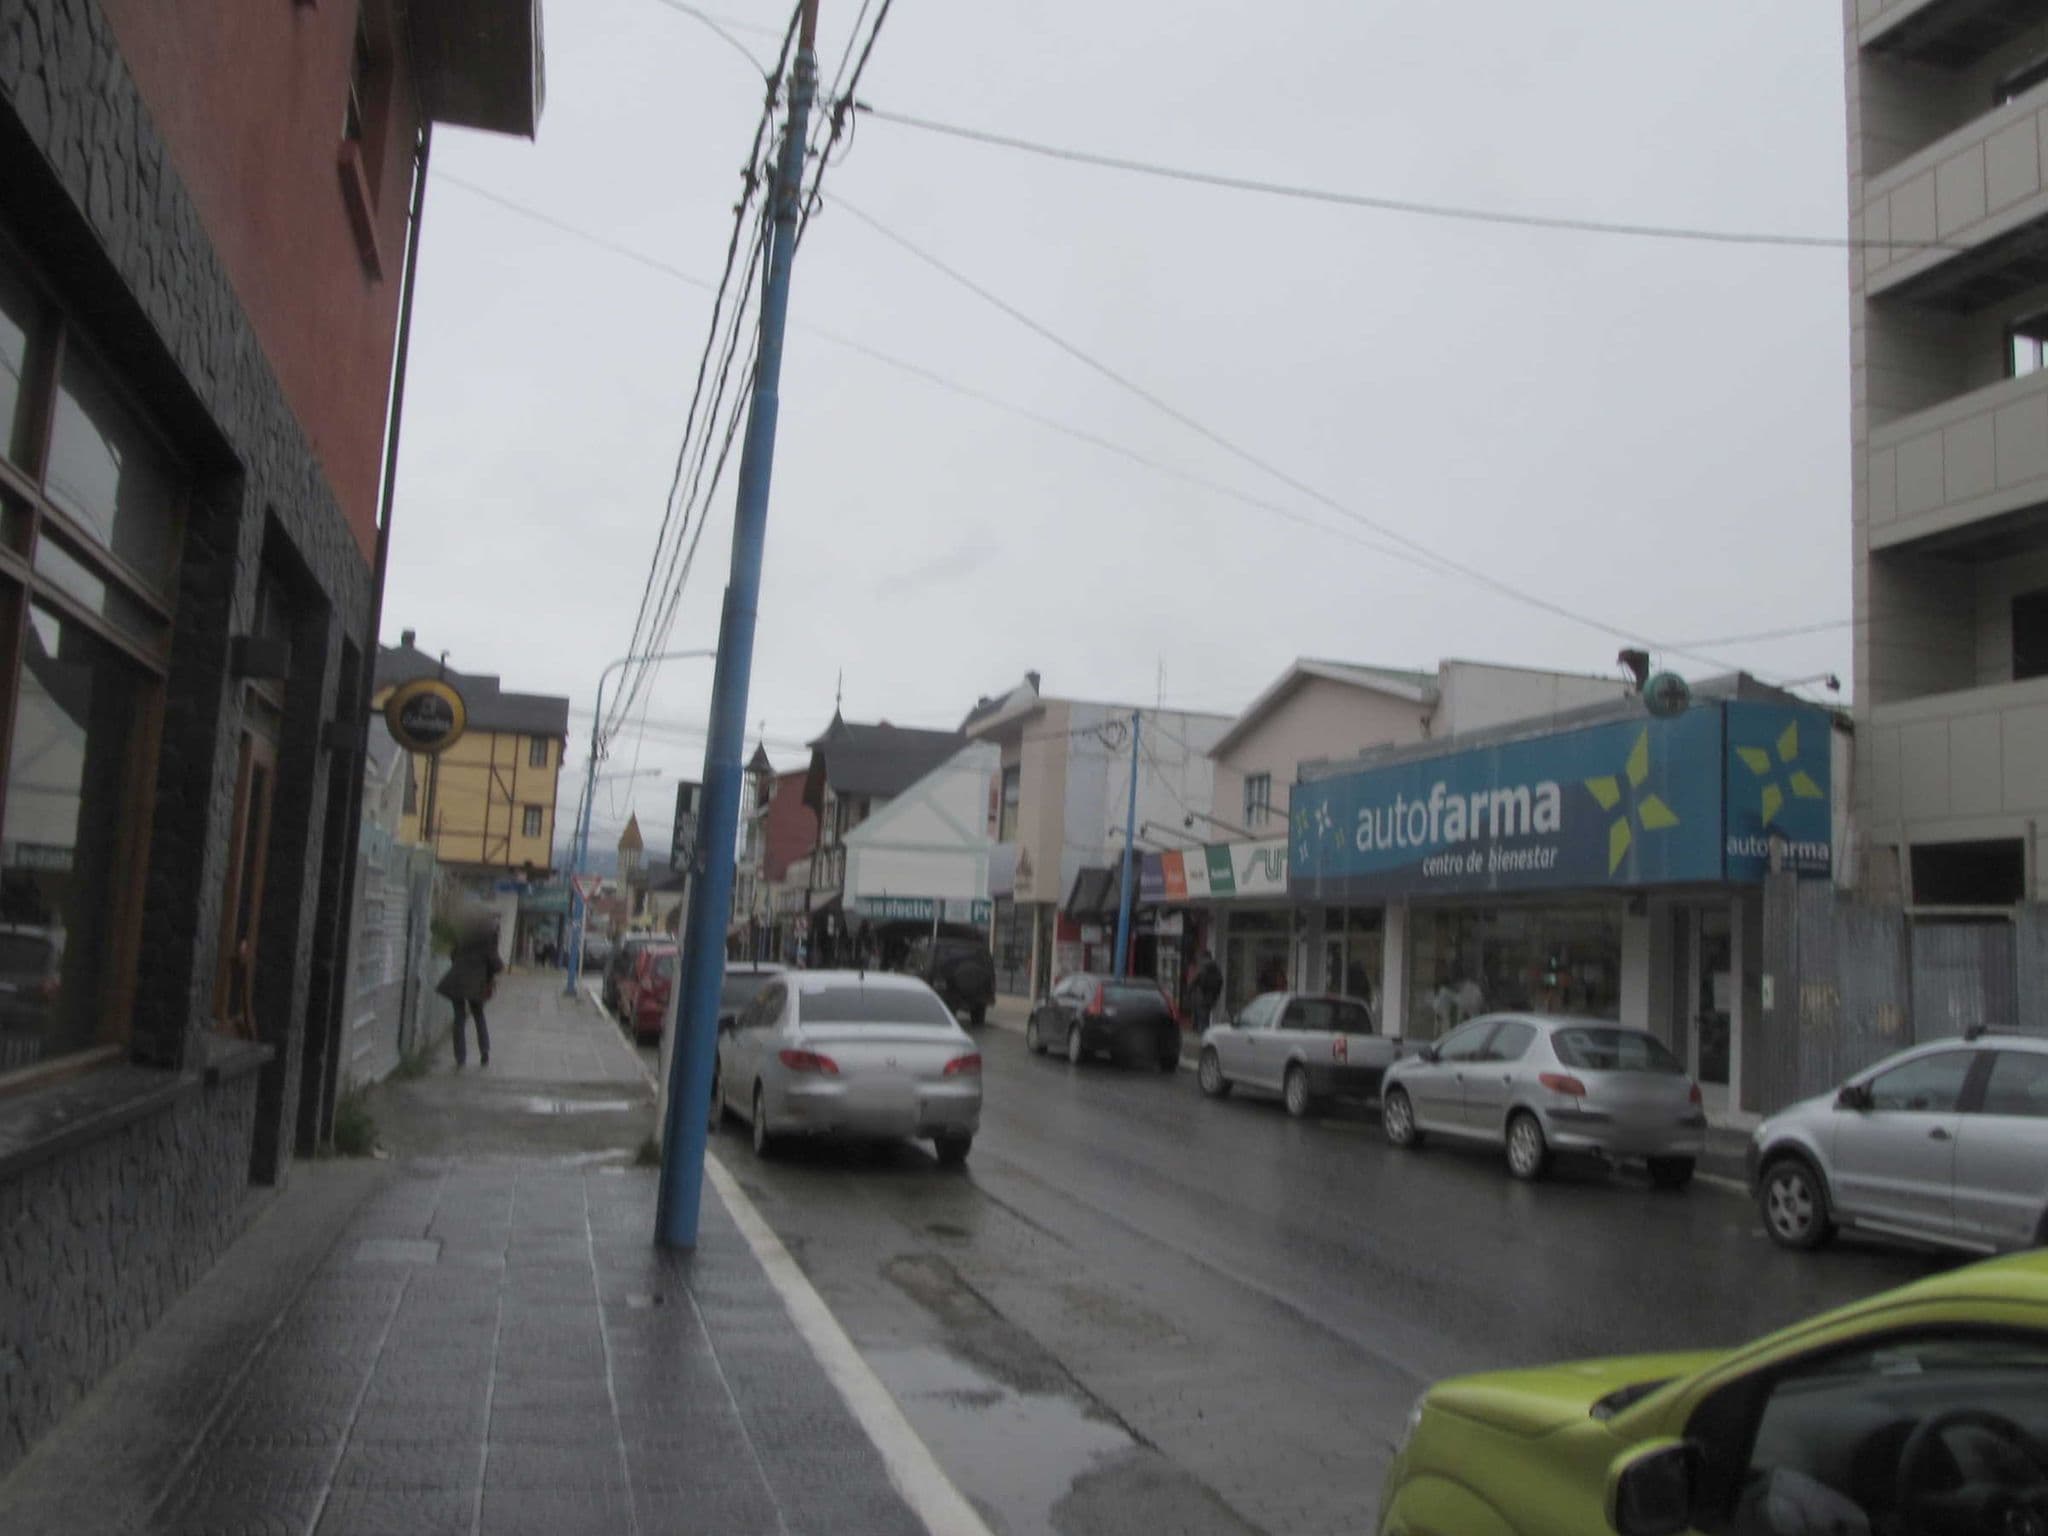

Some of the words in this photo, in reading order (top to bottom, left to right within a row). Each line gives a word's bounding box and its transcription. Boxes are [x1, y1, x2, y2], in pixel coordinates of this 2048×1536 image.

[1356, 781, 1561, 852] autofarma
[1423, 854, 1463, 877] centro
[1466, 849, 1483, 873] de
[1488, 845, 1557, 873] bienestar
